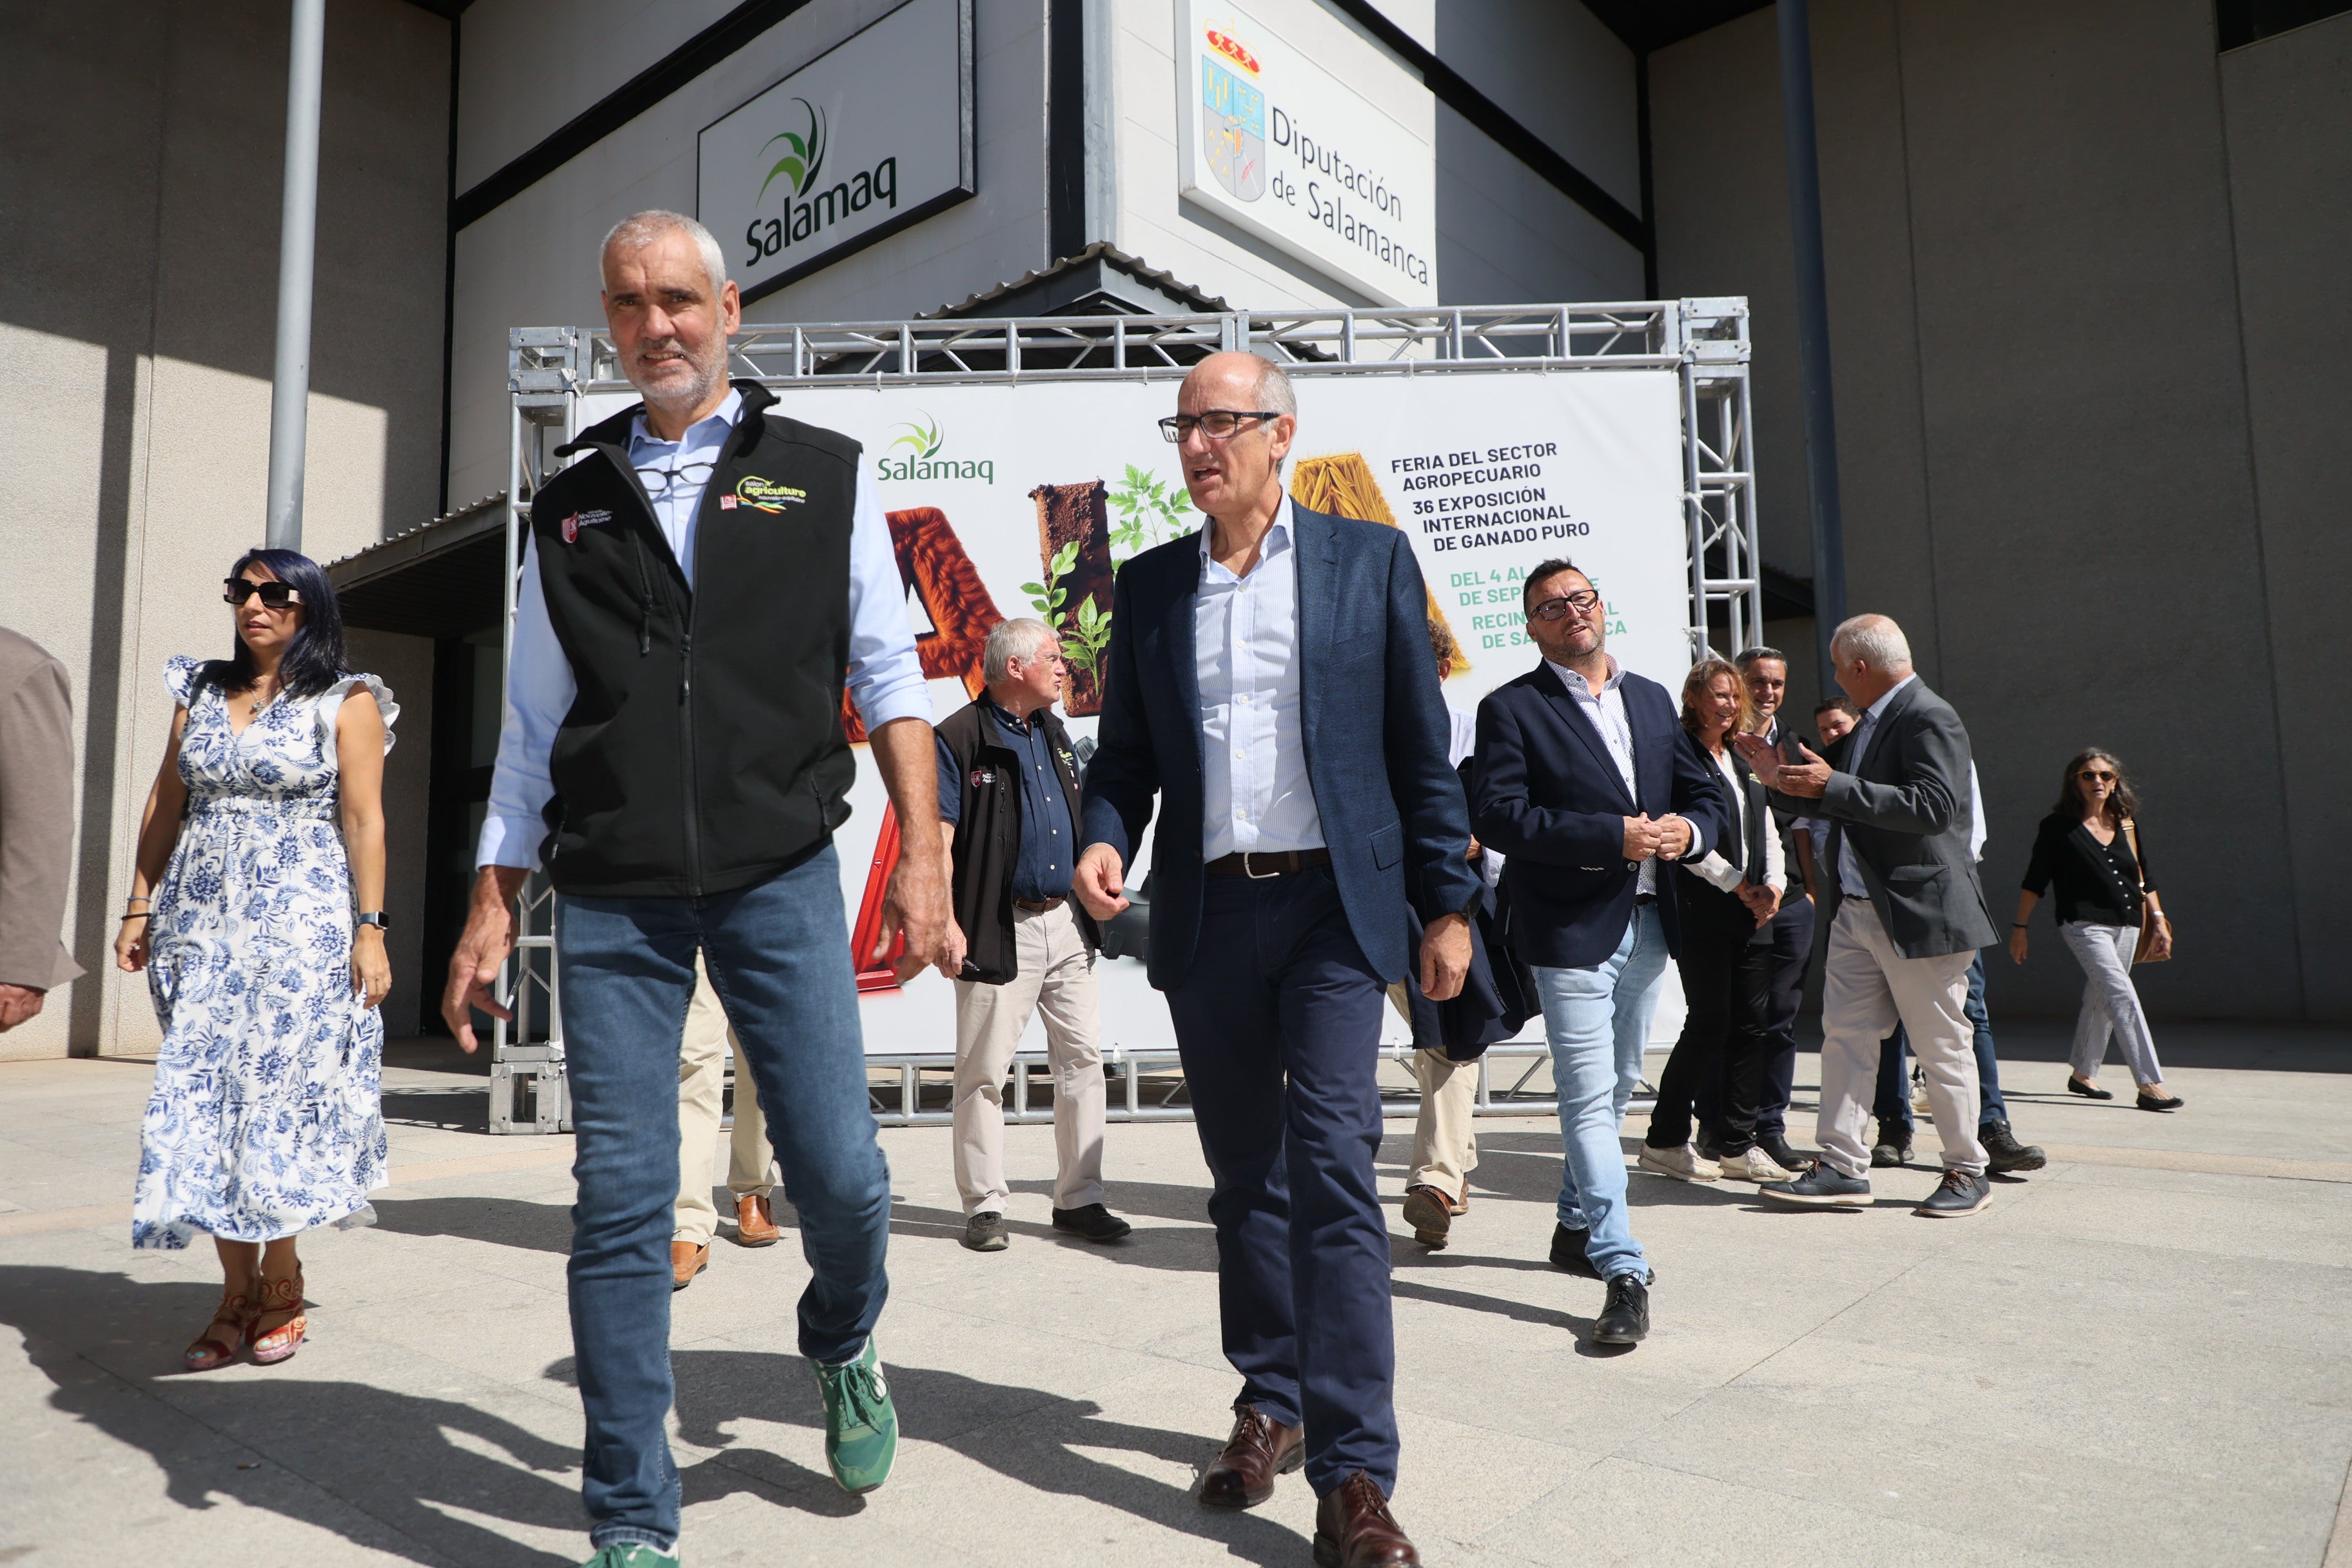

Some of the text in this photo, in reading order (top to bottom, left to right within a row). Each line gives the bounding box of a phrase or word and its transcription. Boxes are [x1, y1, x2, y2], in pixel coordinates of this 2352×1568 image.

[1272, 106, 1402, 222] Diputación
[745, 156, 897, 268] Salamaq
[1272, 170, 1429, 286] de Salamanca
[877, 455, 994, 485] Salamaq
[1391, 442, 1558, 473] FERIA DEL SECTOR
[744, 485, 807, 498] agriculture
[1402, 464, 1541, 492] AGROPECUARIO
[1412, 485, 1546, 515] 36 EXPOSICIÓN
[1422, 505, 1571, 533] INTERNACIONAL
[1433, 522, 1591, 552] DE GANADO PURO
[1451, 566, 1528, 587] DEL 4 AL
[1459, 591, 1482, 607] DE
[1472, 610, 1527, 630] RECIN
[1482, 633, 1505, 649] DE
